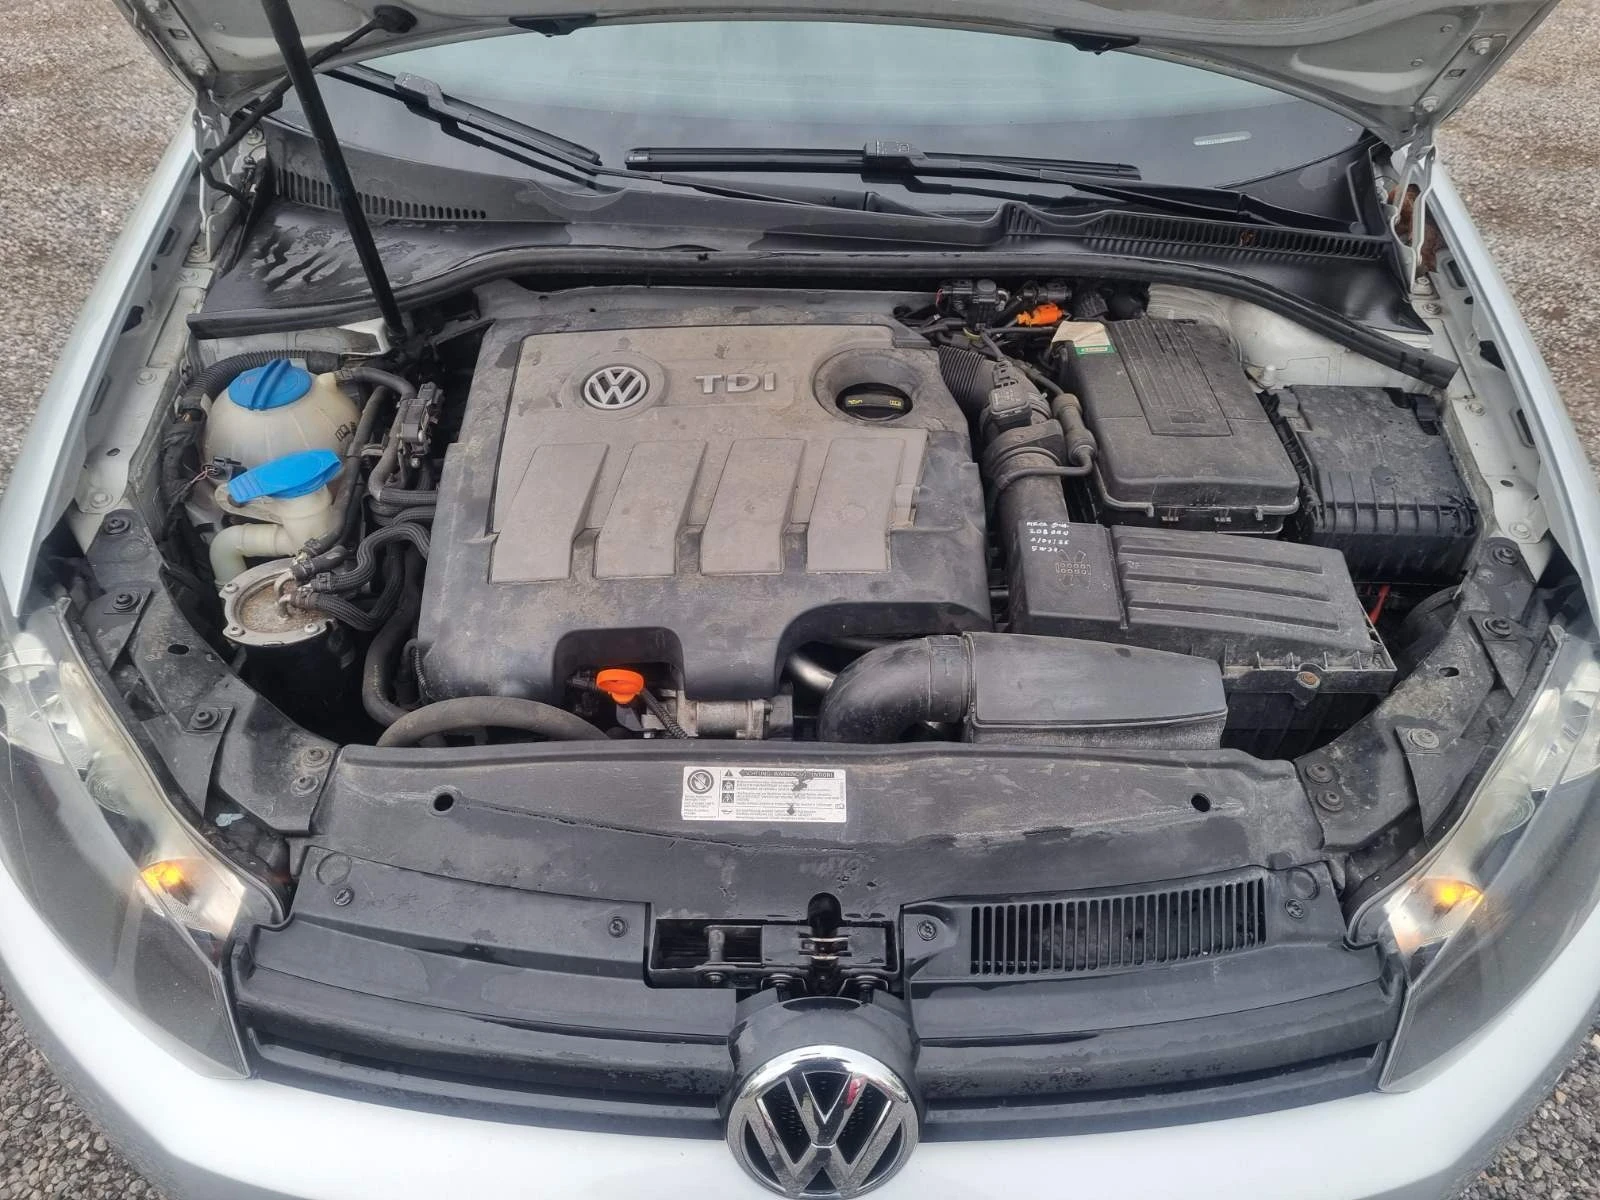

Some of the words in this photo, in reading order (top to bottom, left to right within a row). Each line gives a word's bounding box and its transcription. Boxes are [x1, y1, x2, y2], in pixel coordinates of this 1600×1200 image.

[583, 366, 650, 410] VW
[695, 372, 775, 394] TDI
[727, 1044, 919, 1200] VW
